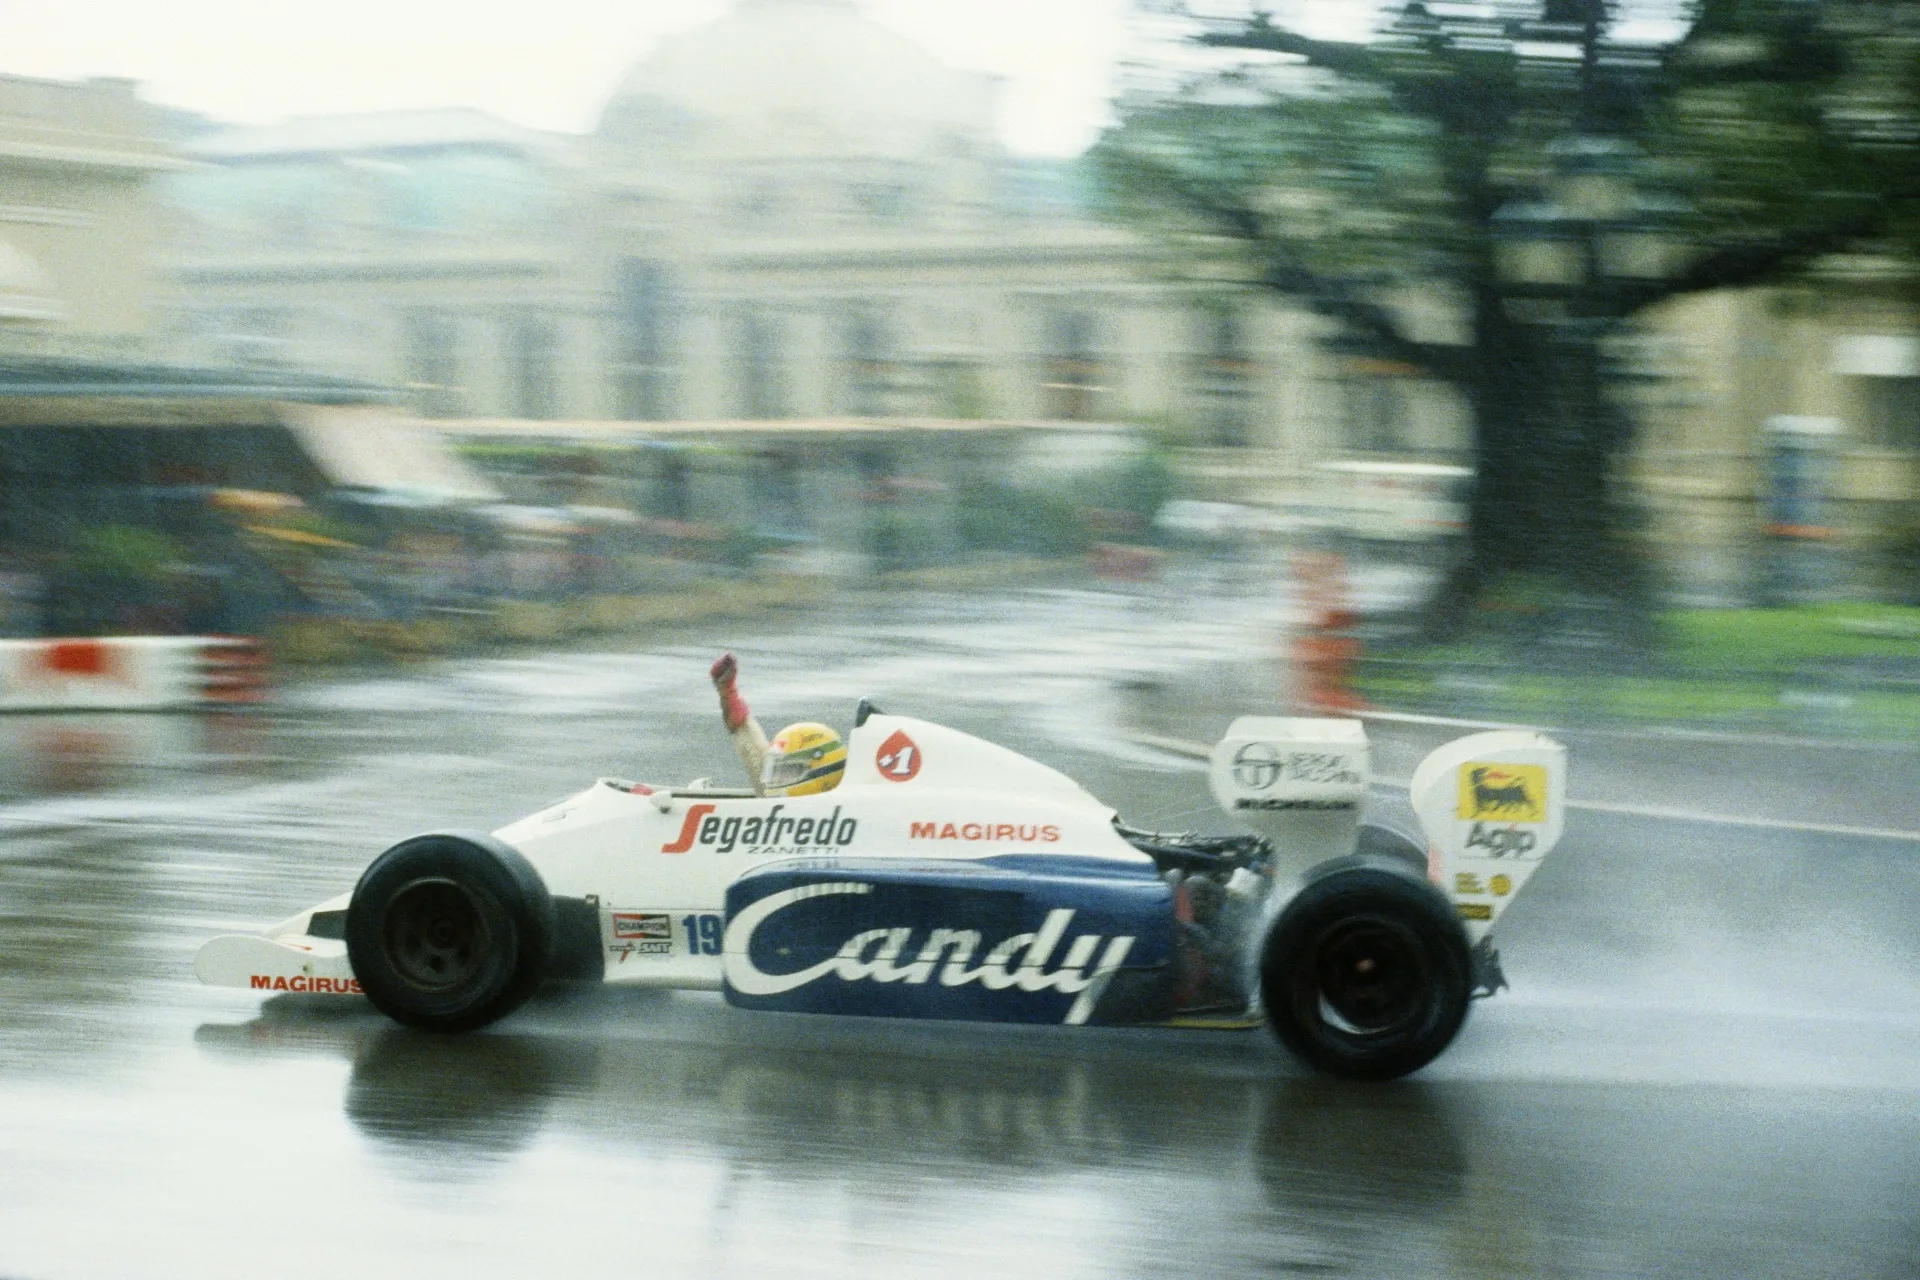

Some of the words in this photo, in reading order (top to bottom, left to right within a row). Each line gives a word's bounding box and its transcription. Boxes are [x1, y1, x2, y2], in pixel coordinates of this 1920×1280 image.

[661, 804, 857, 854] Segafredo
[910, 822, 1061, 842] MAGIRUS
[747, 845, 840, 855] ZANETTI
[682, 914, 723, 955] 19
[723, 882, 1137, 1025] Candy
